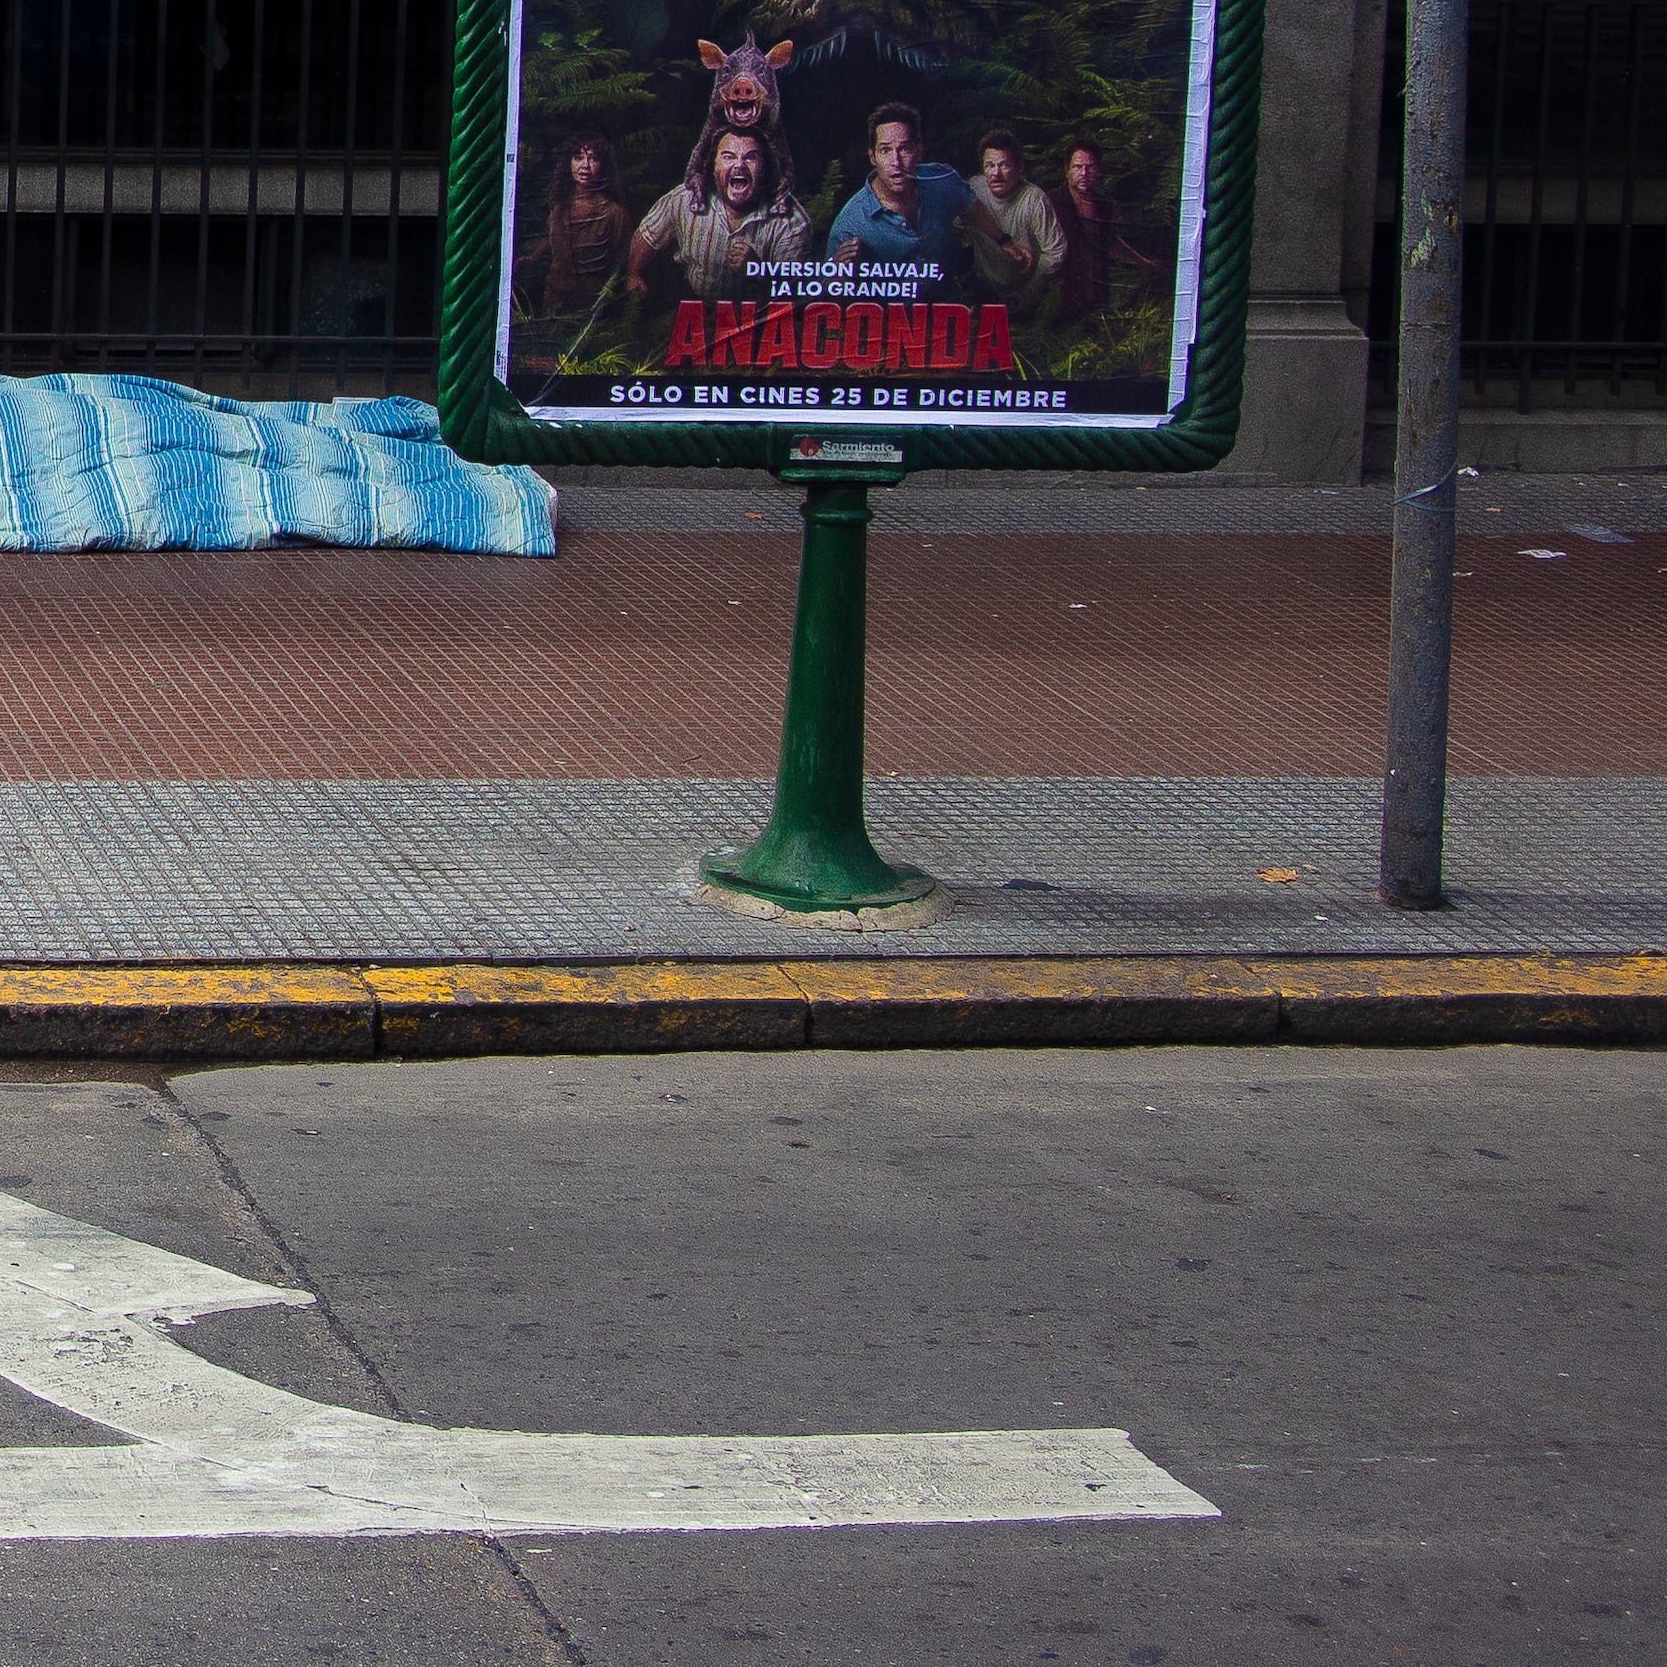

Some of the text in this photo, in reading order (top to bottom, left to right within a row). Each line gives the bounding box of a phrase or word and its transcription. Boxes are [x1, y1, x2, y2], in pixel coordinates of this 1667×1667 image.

[746, 257, 945, 281] DIVERSIÓN SALVAJE,
[770, 279, 918, 299] ¡A LO GRANDE!
[664, 300, 1015, 372] ANACONDA
[610, 381, 1066, 409] SÓLO EN CINES 25 DE DICIEMBRE
[822, 440, 895, 453] Sarmiento
